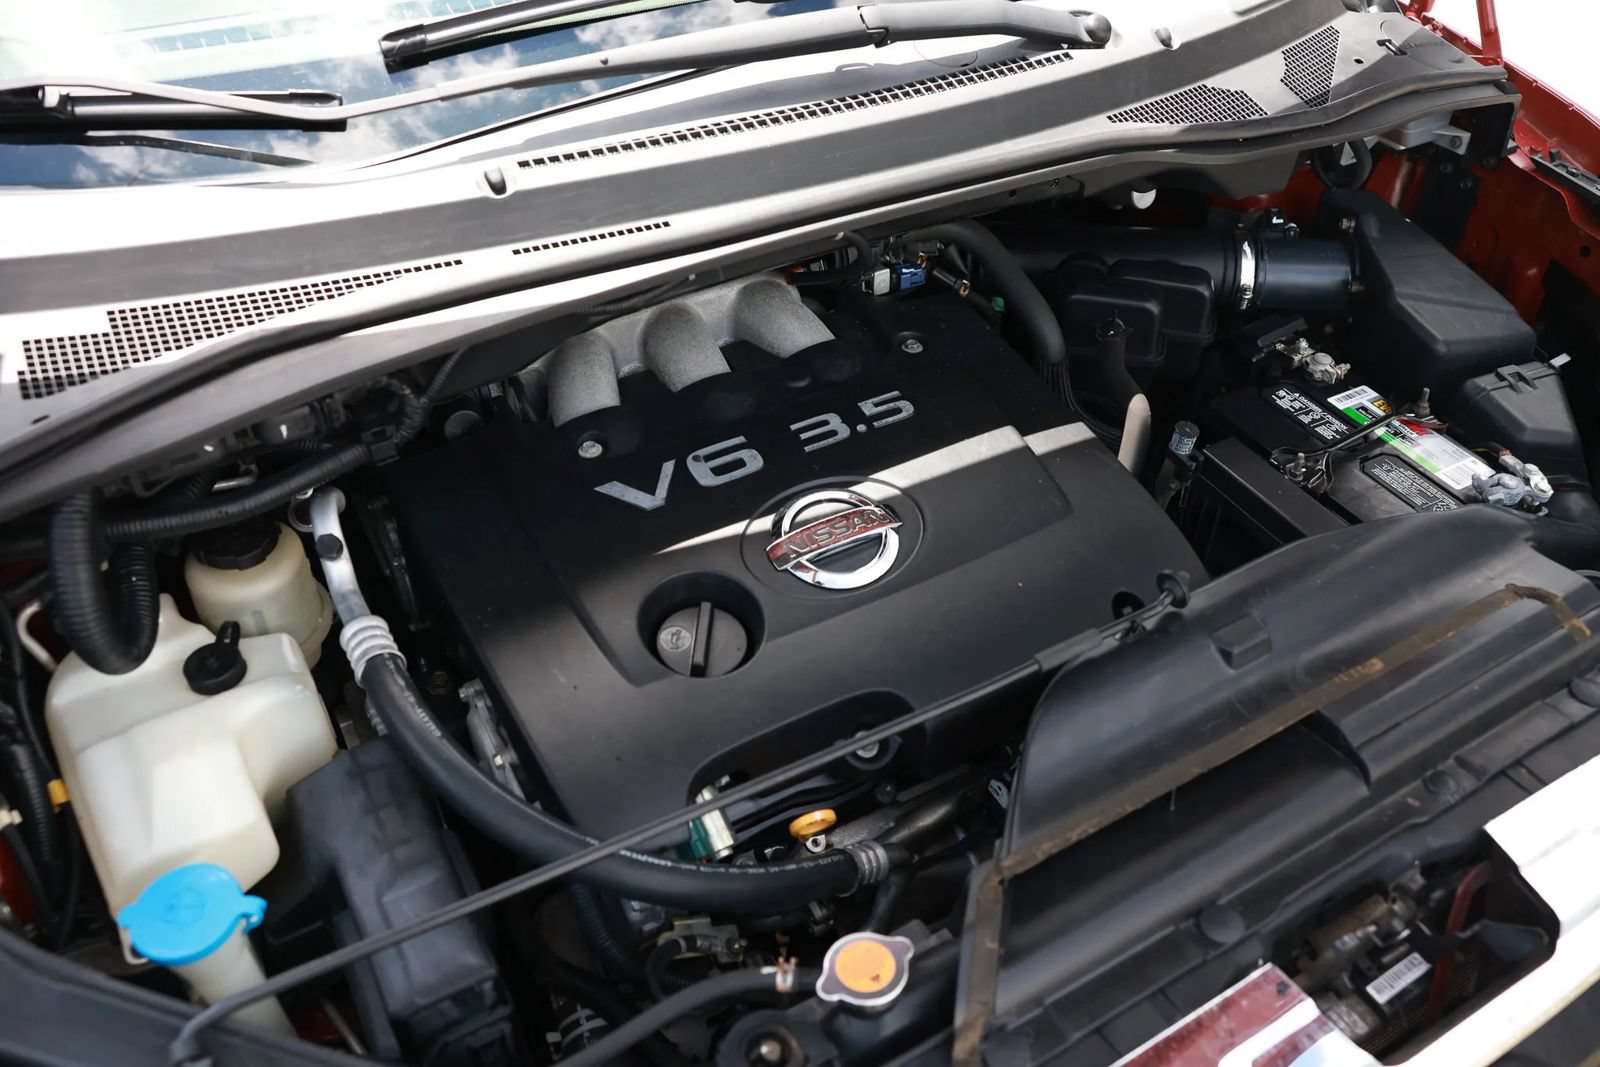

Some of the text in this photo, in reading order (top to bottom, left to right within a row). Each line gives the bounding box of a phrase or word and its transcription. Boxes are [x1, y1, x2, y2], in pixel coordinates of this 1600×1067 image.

[593, 390, 914, 511] V6 3.5
[784, 509, 890, 558] NISSAN
